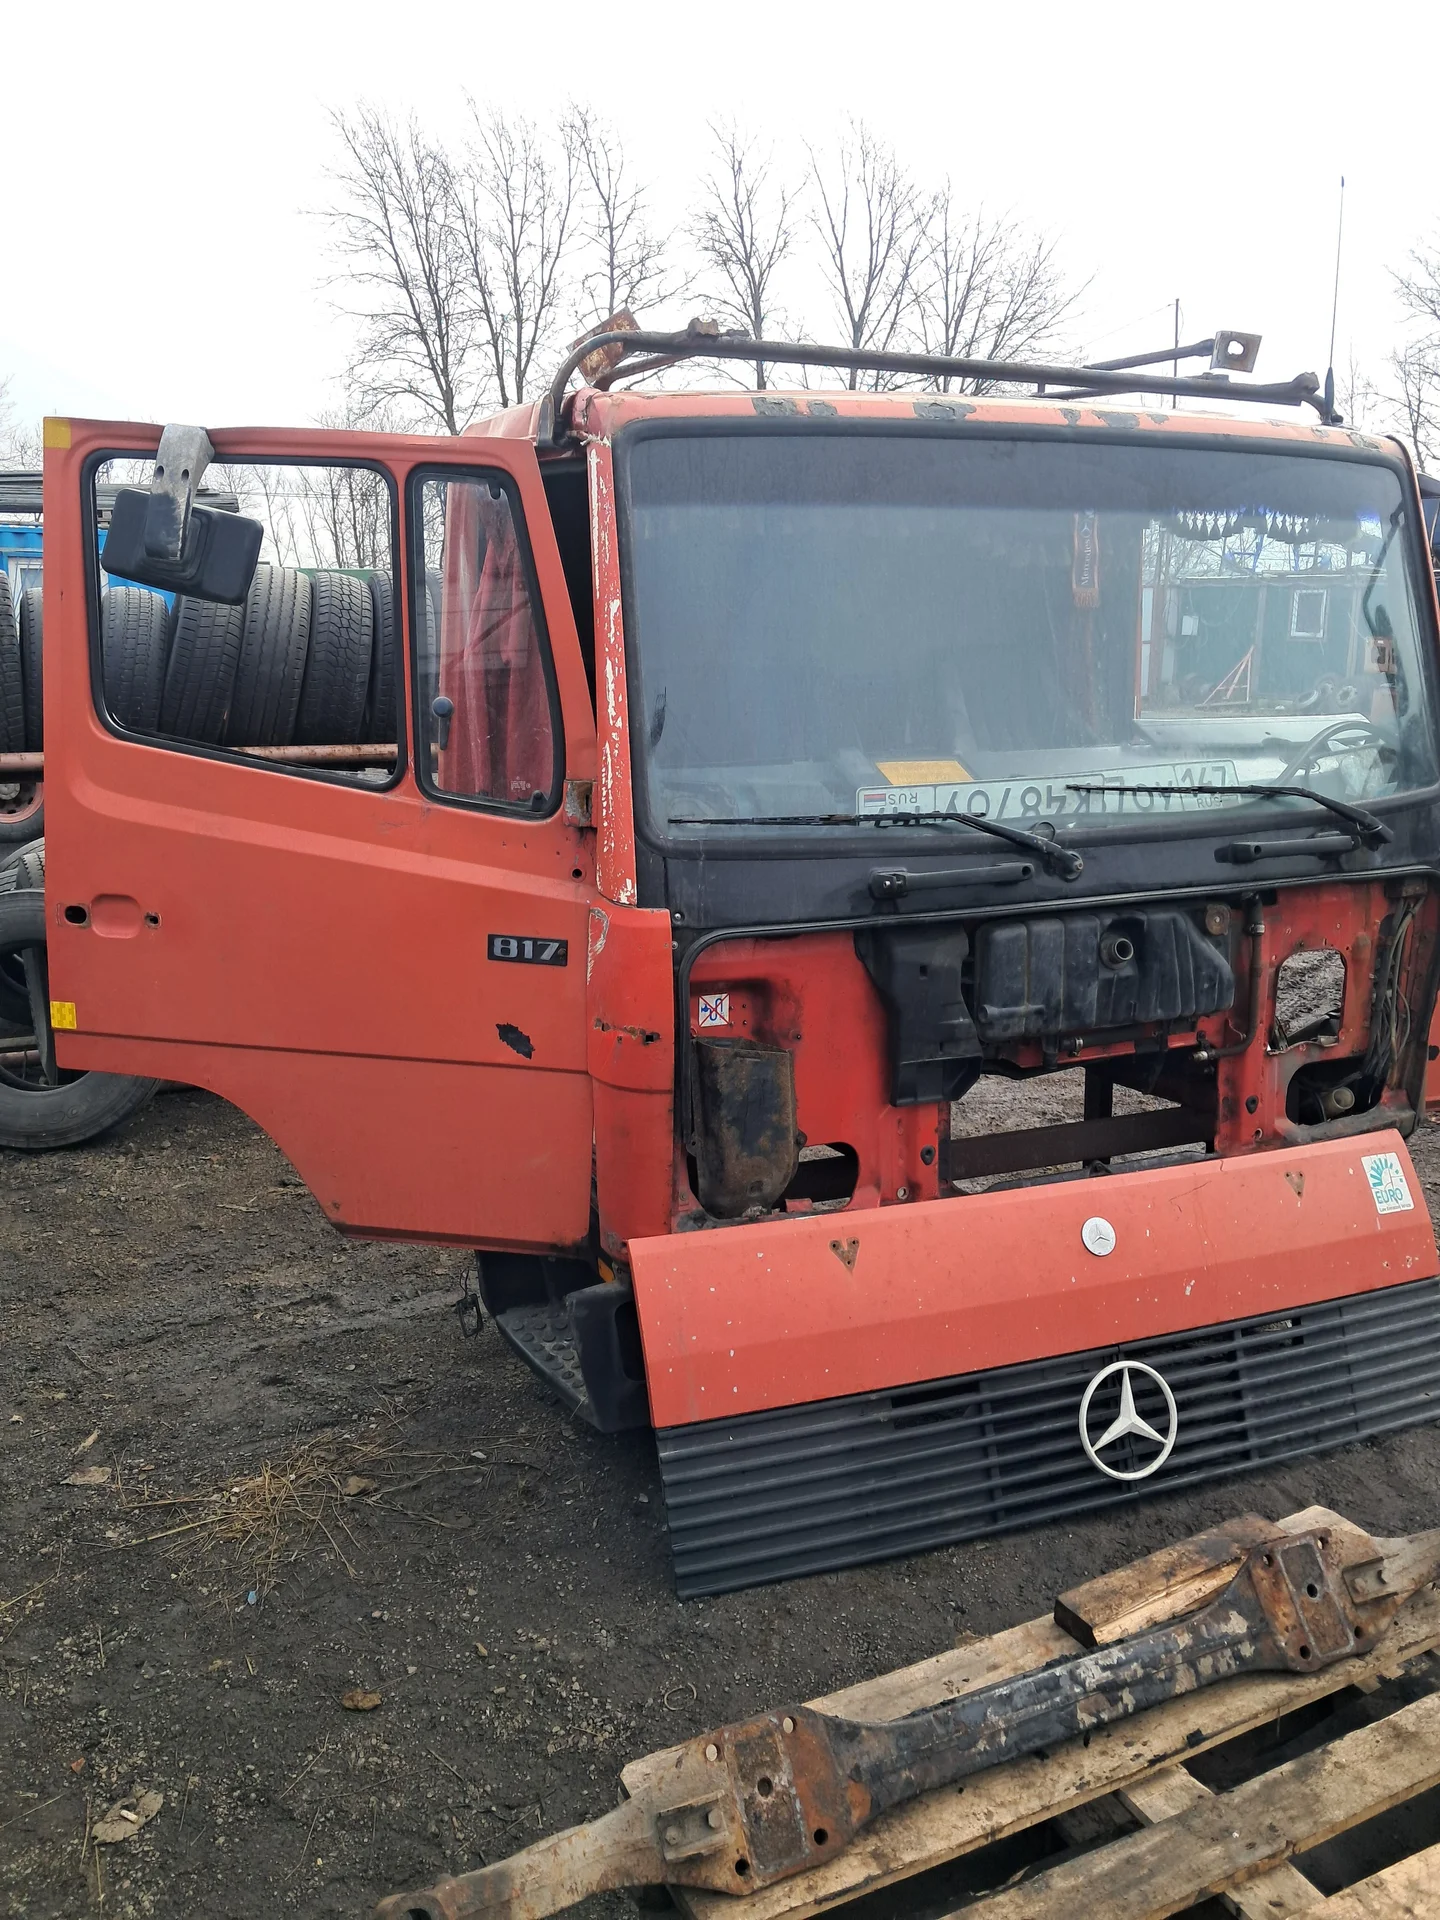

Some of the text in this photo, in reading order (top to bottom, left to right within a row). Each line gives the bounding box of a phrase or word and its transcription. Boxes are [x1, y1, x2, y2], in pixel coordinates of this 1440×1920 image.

[1081, 538, 1092, 586] Mercedes
[887, 792, 918, 805] RUS
[1197, 796, 1222, 809] RUS
[493, 937, 560, 961] 817
[1375, 1187, 1403, 1204] EURO
